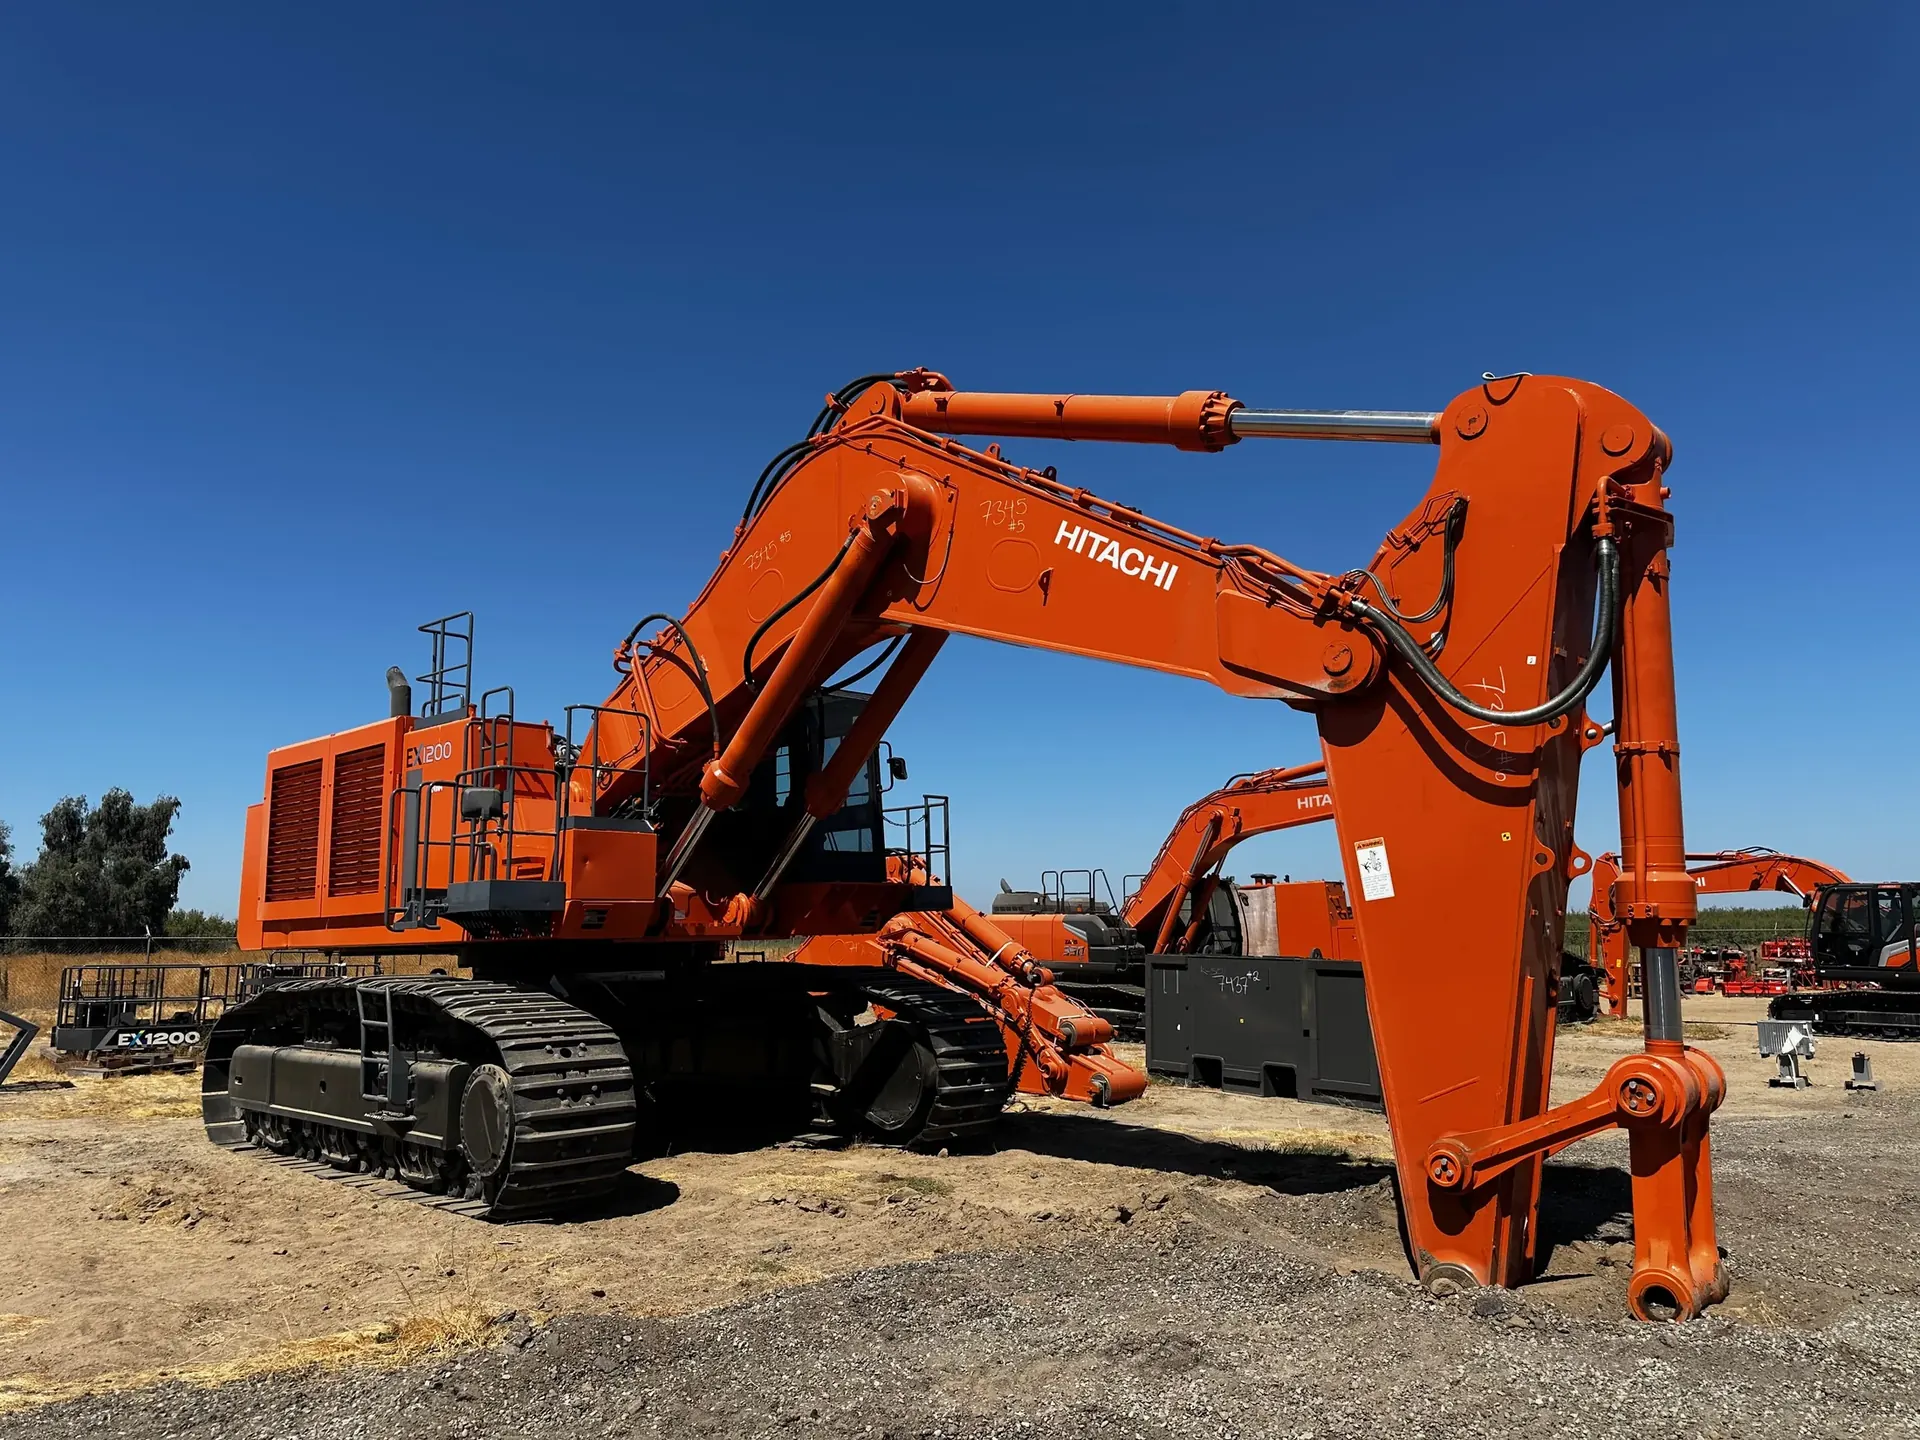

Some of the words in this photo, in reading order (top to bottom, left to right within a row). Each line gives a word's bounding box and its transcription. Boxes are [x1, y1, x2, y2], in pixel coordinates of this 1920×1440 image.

[979, 497, 1028, 527] 7345
[1007, 519, 1026, 534] #5
[1053, 519, 1179, 591] HITACHI
[406, 741, 452, 768] EX1200
[1296, 793, 1333, 810] HITA
[118, 1029, 200, 1048] EX1200
